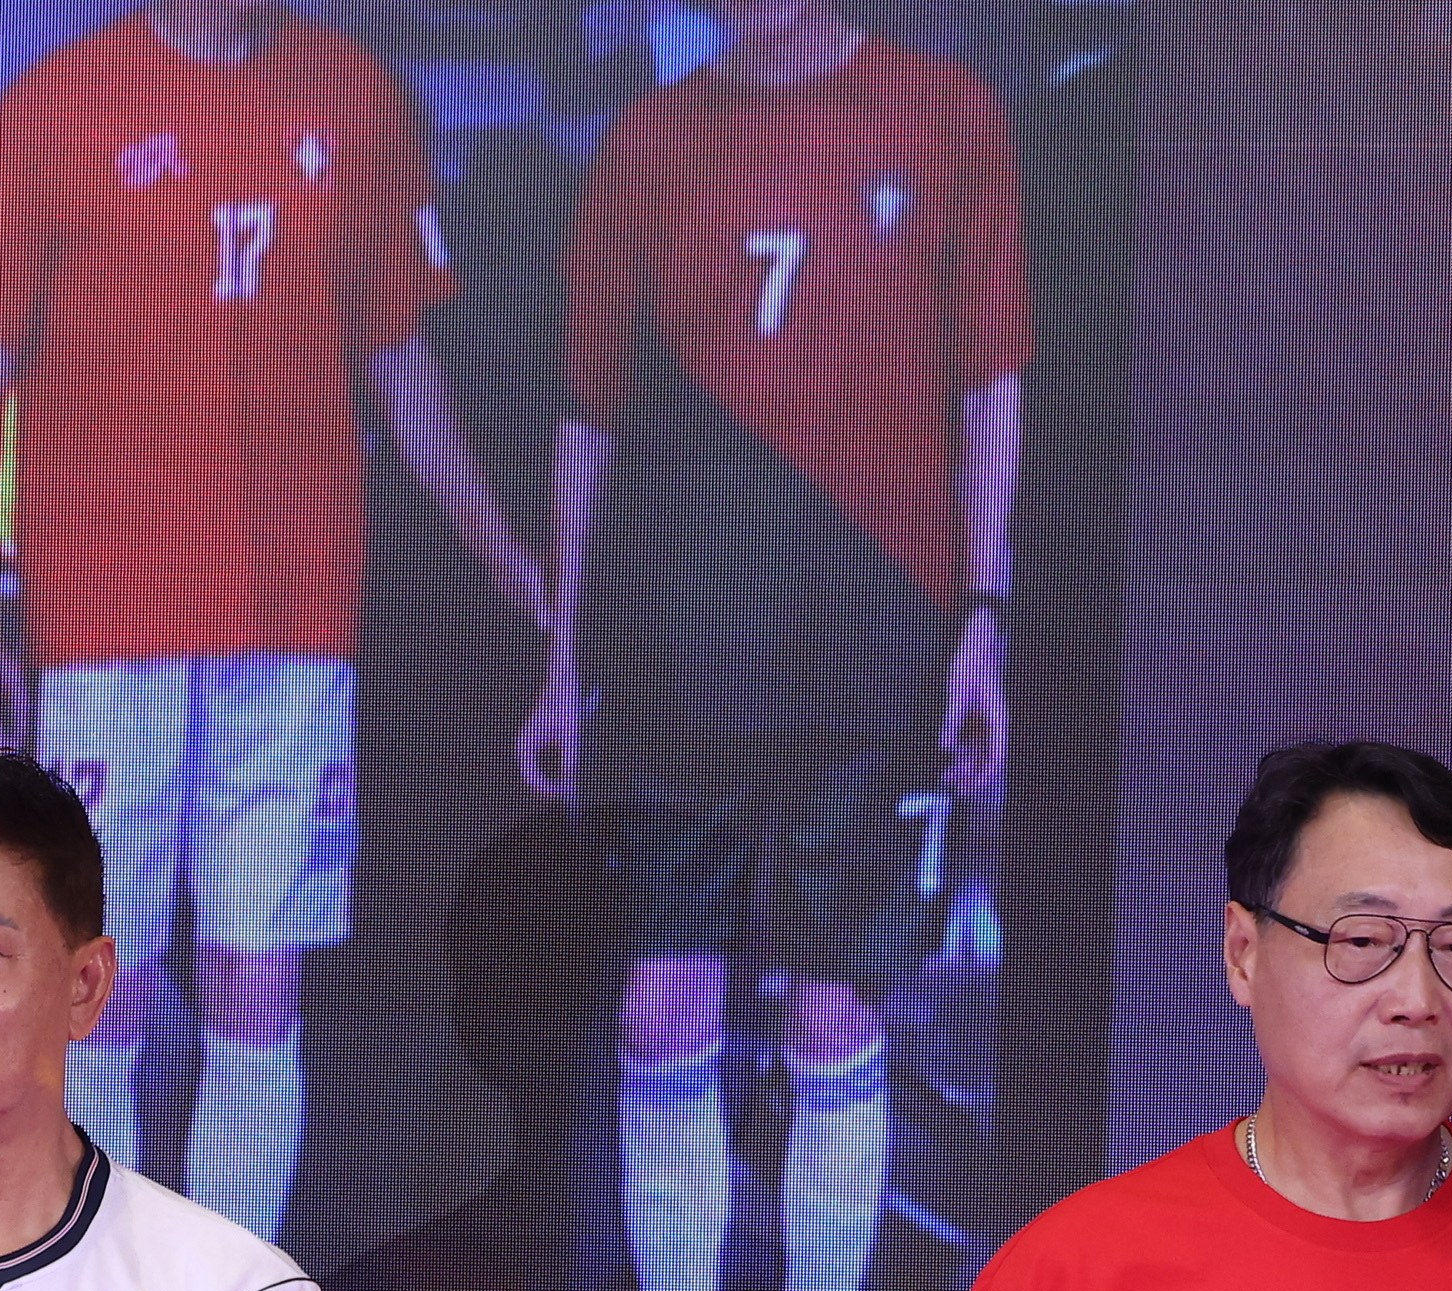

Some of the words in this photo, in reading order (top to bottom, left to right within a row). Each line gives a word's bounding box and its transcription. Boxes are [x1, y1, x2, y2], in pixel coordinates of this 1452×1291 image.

[211, 203, 277, 301] 17
[748, 232, 806, 337] 7
[898, 795, 953, 898] 7
